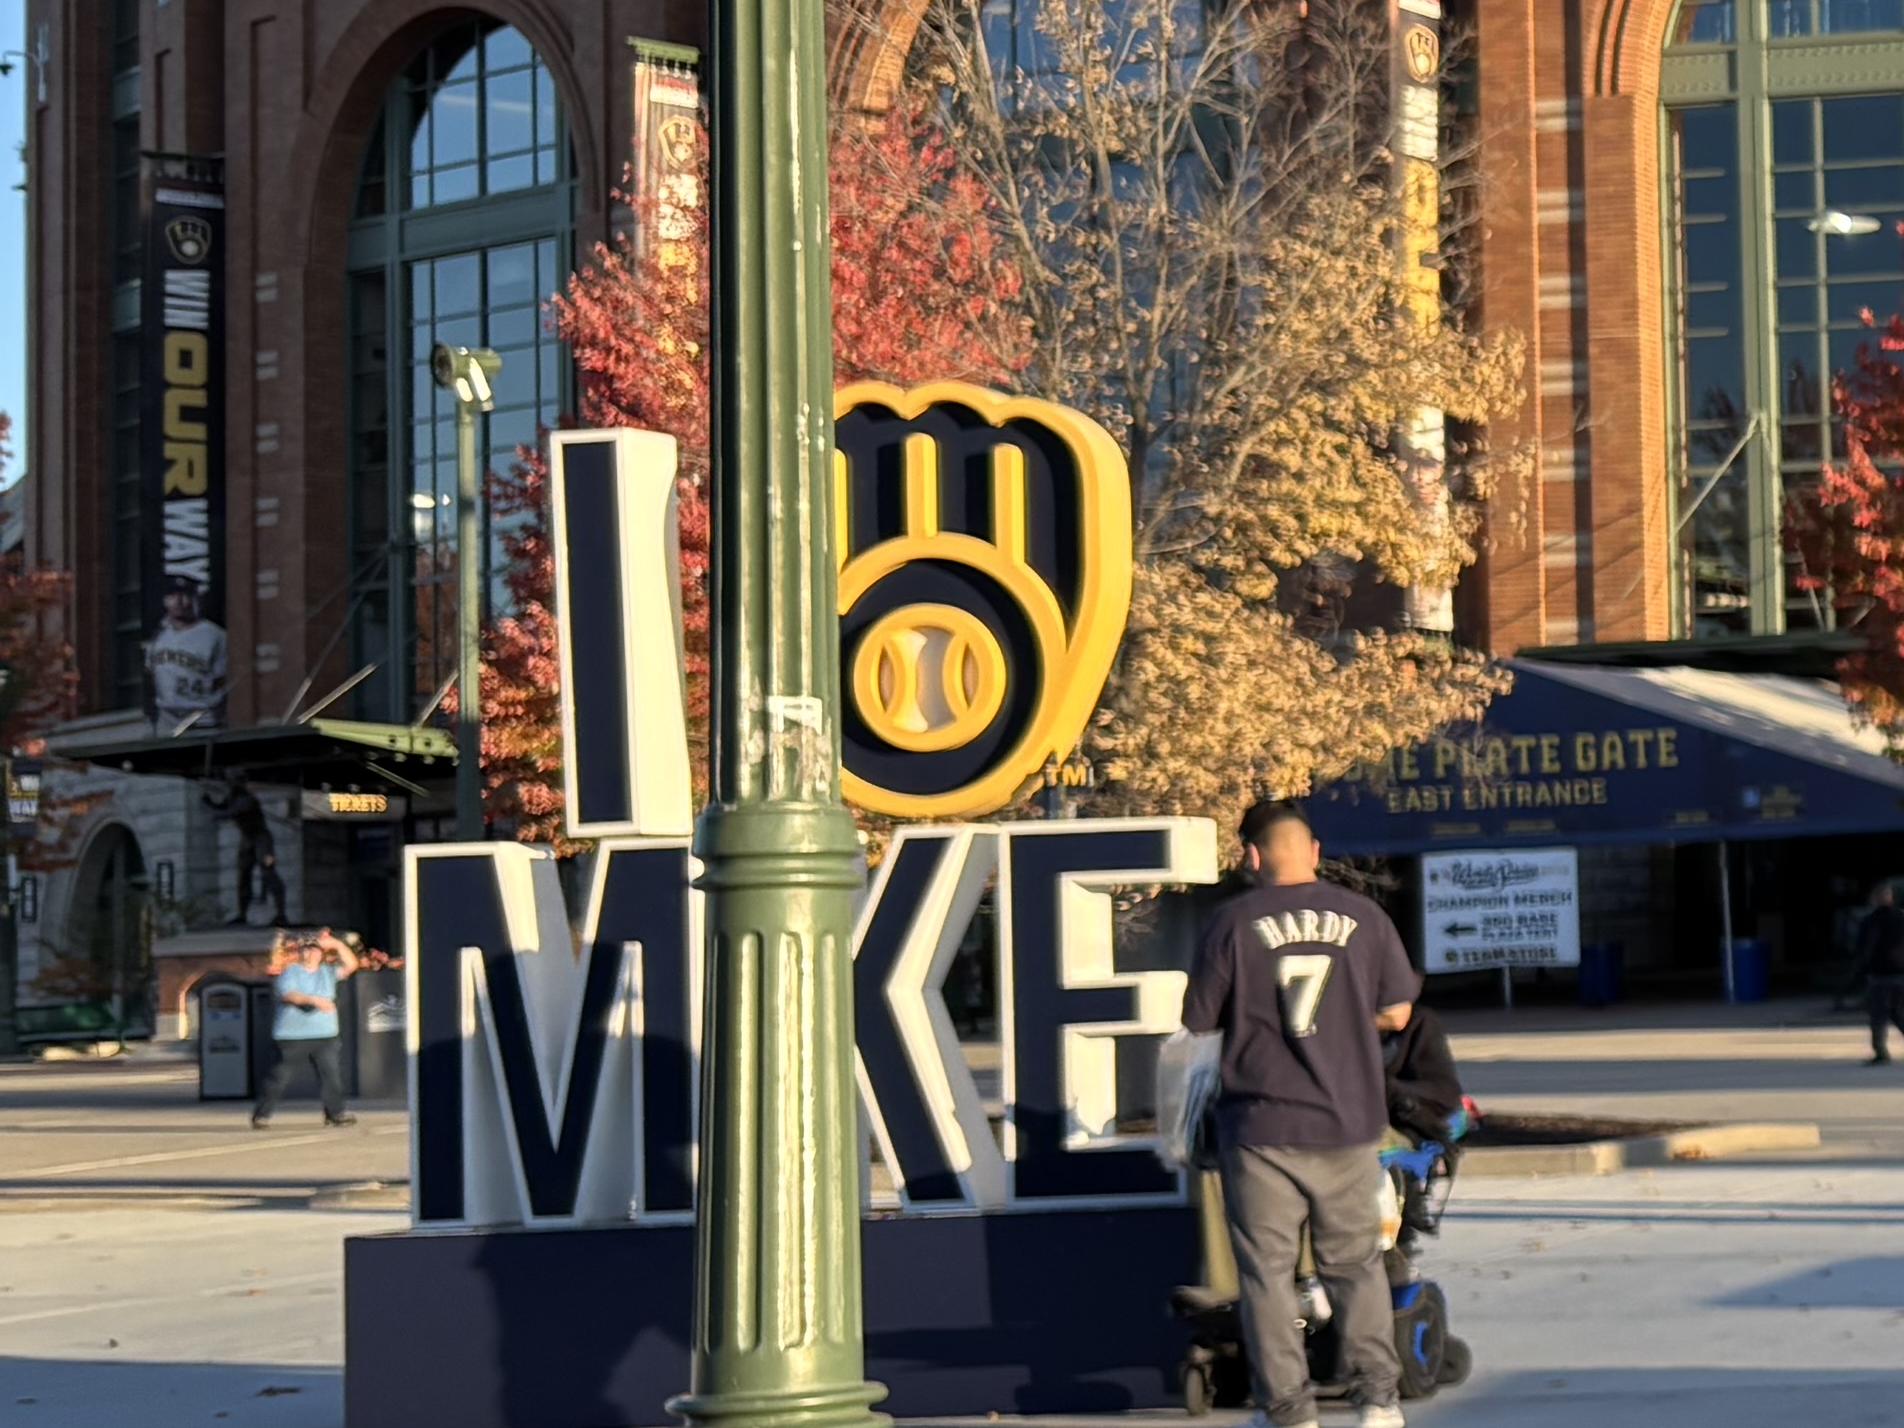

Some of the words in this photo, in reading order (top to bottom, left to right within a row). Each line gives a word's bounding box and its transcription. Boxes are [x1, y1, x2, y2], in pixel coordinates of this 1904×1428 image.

[163, 329, 209, 498] OUR
[1433, 732, 1562, 781] PLATE
[1574, 726, 1680, 773] GATE
[328, 791, 388, 813] TICKETS
[1387, 784, 1455, 814] EAST
[1462, 777, 1609, 812] ENTRANCE
[1253, 908, 1359, 950] HARDY
[1278, 954, 1333, 1038] 7
